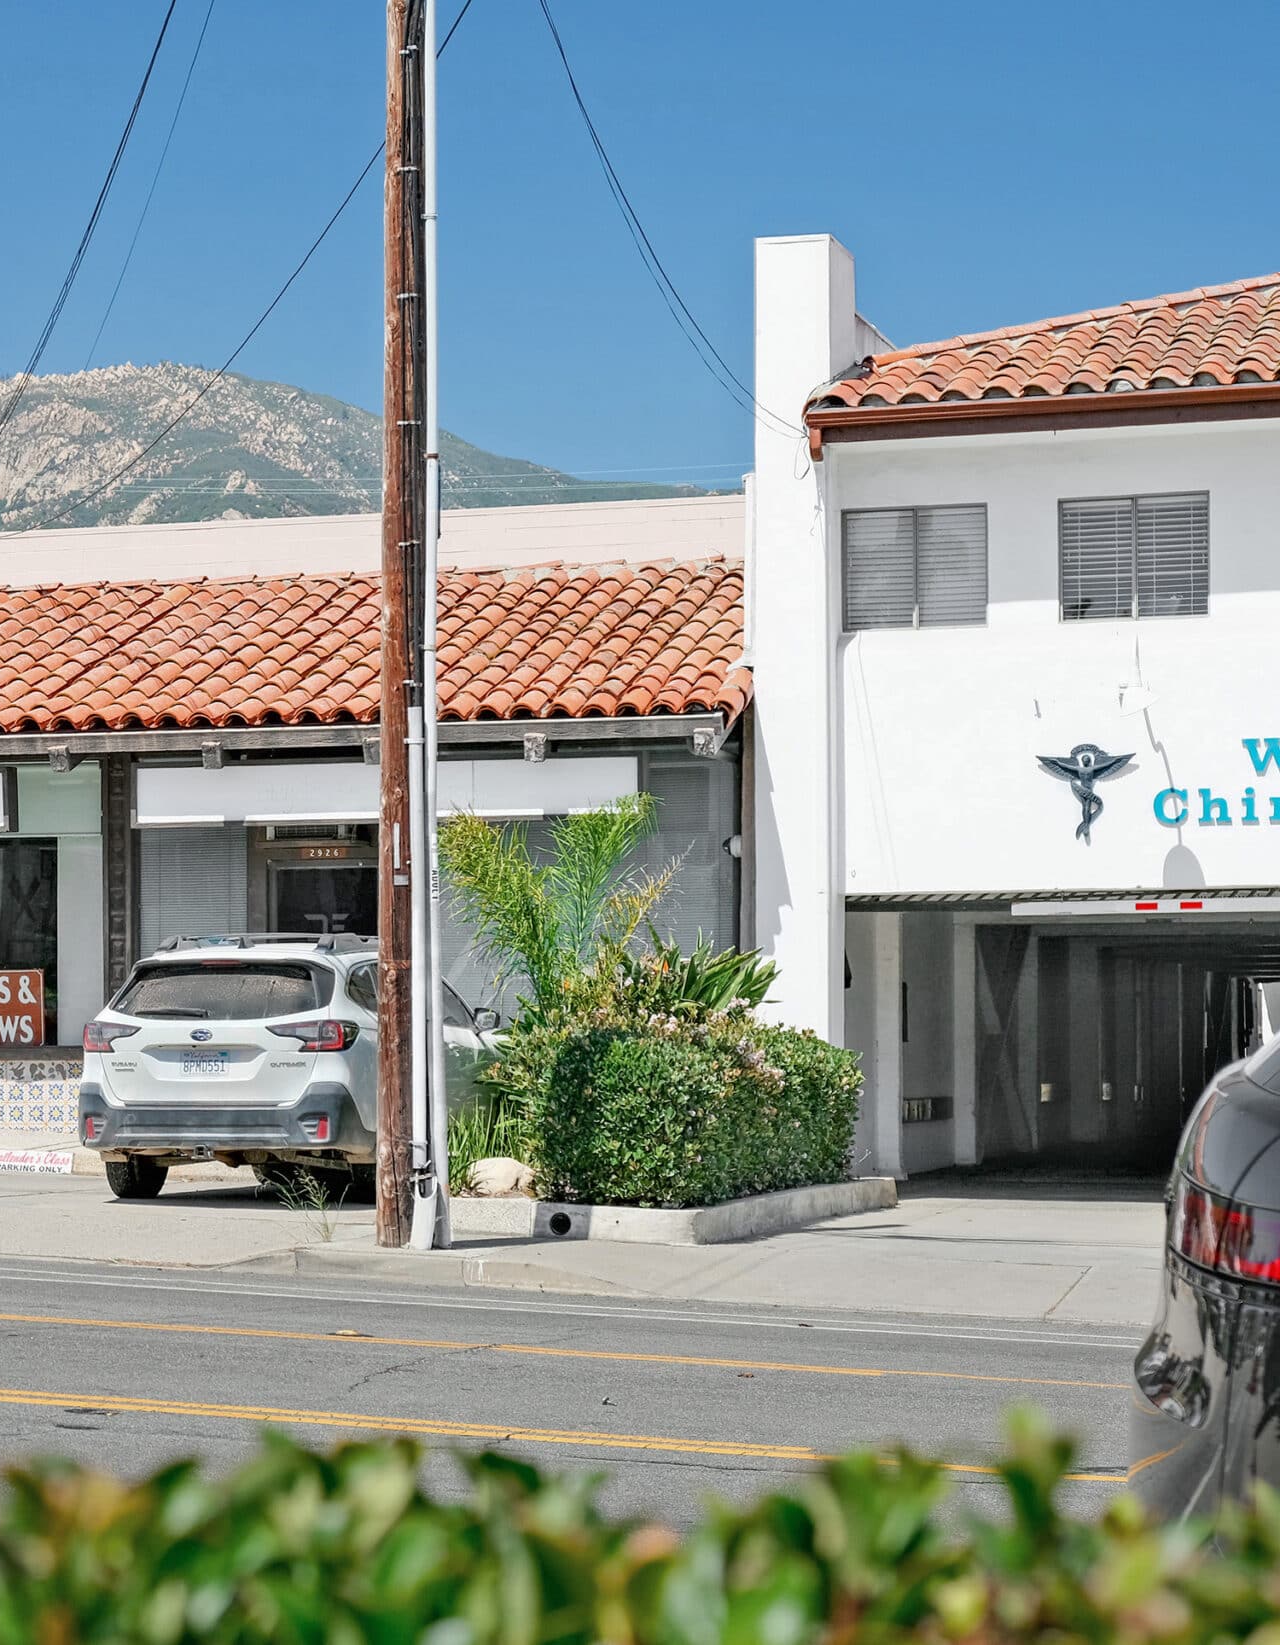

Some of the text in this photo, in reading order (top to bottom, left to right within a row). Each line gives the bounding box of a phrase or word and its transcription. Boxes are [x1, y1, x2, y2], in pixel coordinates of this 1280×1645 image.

[310, 848, 339, 857] 2926
[18, 975, 37, 1005] &
[183, 1059, 225, 1073] 8PMD551
[38, 1165, 63, 1173] ONLY
